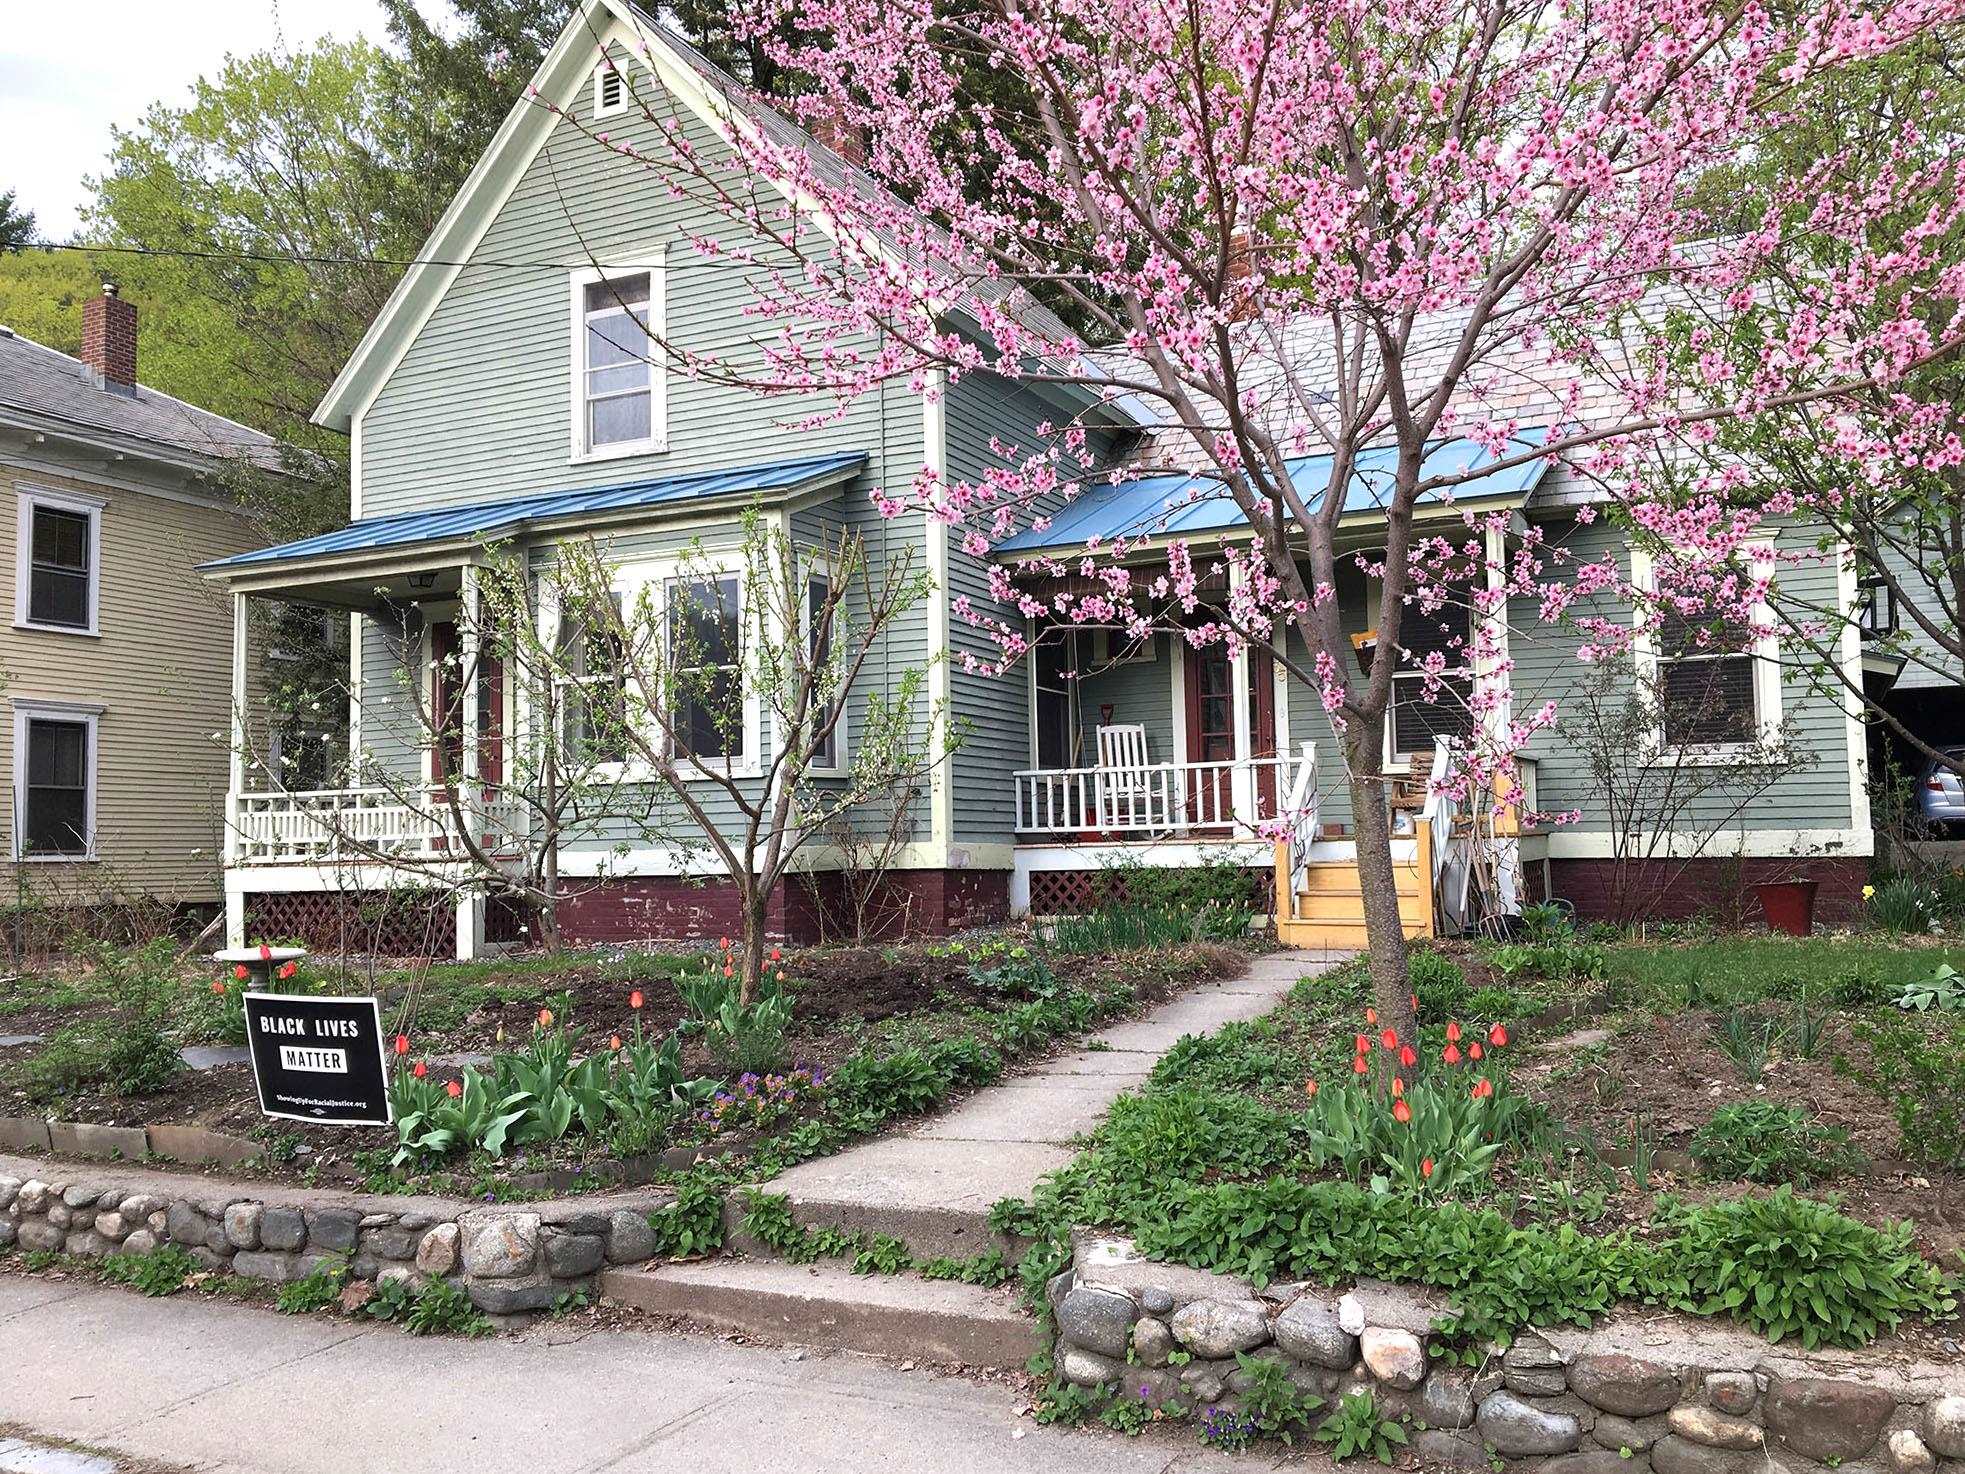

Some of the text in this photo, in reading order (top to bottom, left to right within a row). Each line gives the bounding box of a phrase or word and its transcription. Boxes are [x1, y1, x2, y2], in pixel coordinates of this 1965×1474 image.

[260, 1016, 359, 1038] BLACK LIVES
[286, 1050, 341, 1069] MATTER
